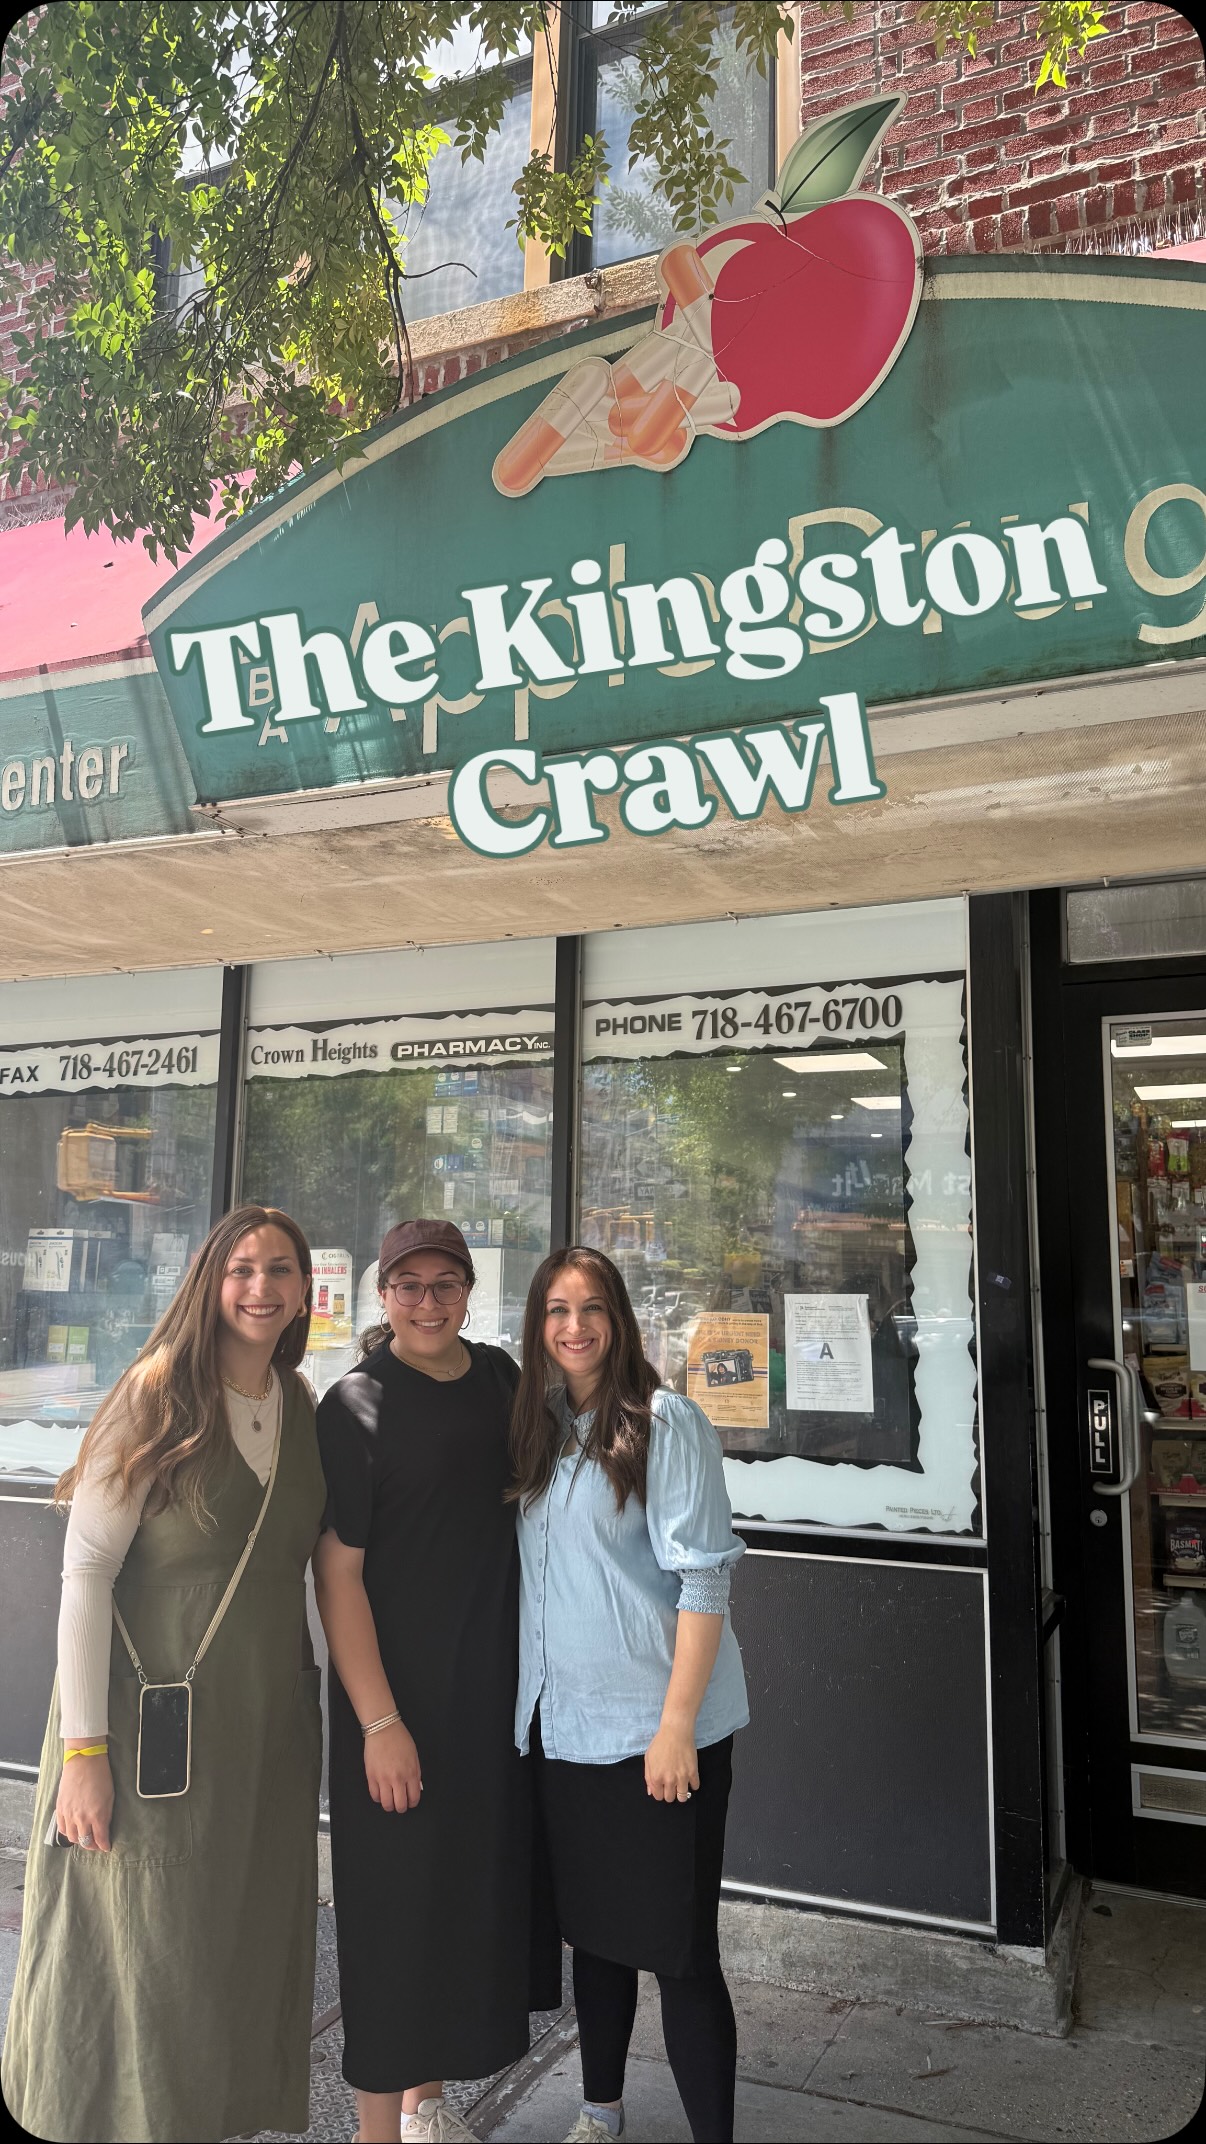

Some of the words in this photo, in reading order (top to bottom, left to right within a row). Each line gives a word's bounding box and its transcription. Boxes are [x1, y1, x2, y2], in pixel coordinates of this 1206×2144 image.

[2, 739, 128, 811] enter
[595, 1012, 682, 1036] PHONE
[691, 994, 903, 1040] 718-467-6700
[0, 1065, 40, 1084] FAX
[59, 1046, 198, 1081] 718-467-2461
[250, 1045, 305, 1066] Crown
[311, 1038, 379, 1064] Heights
[397, 1036, 540, 1058] PHARMACY
[819, 1342, 834, 1359] A
[1093, 1399, 1107, 1464] PULL
